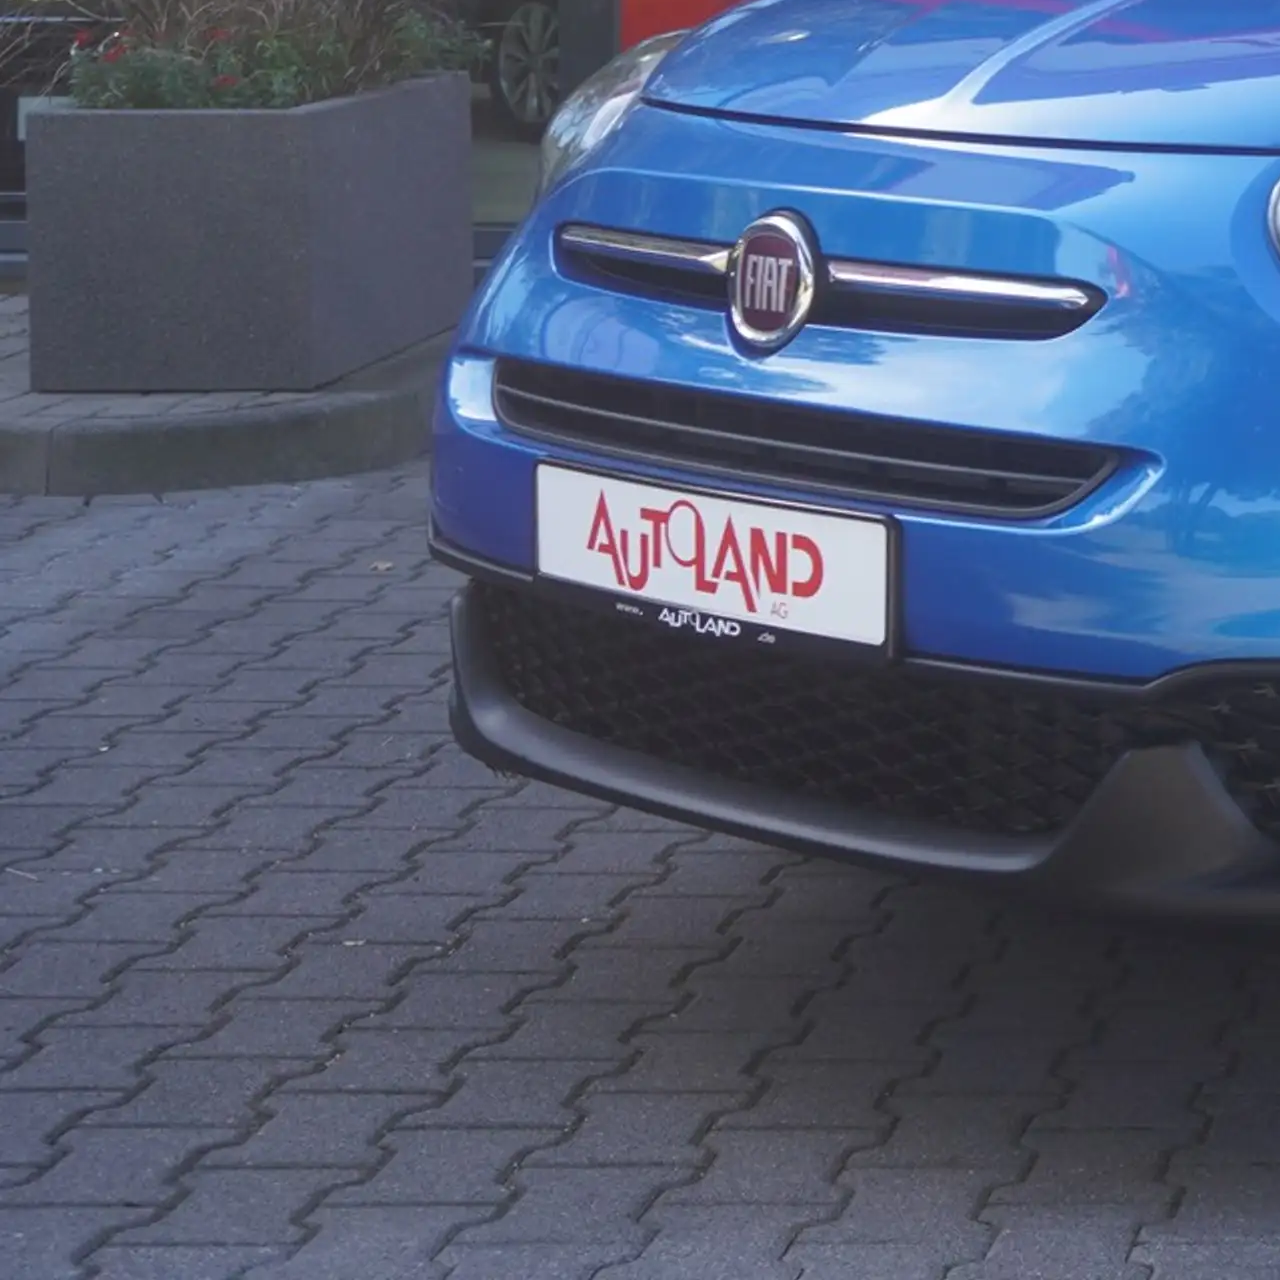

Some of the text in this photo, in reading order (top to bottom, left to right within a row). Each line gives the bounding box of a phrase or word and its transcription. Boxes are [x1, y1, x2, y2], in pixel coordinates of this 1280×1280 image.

[745, 254, 793, 312] FIAT
[586, 488, 824, 612] AUTOLAND
[658, 607, 741, 637] AUTOLAND
[769, 601, 789, 620] AG
